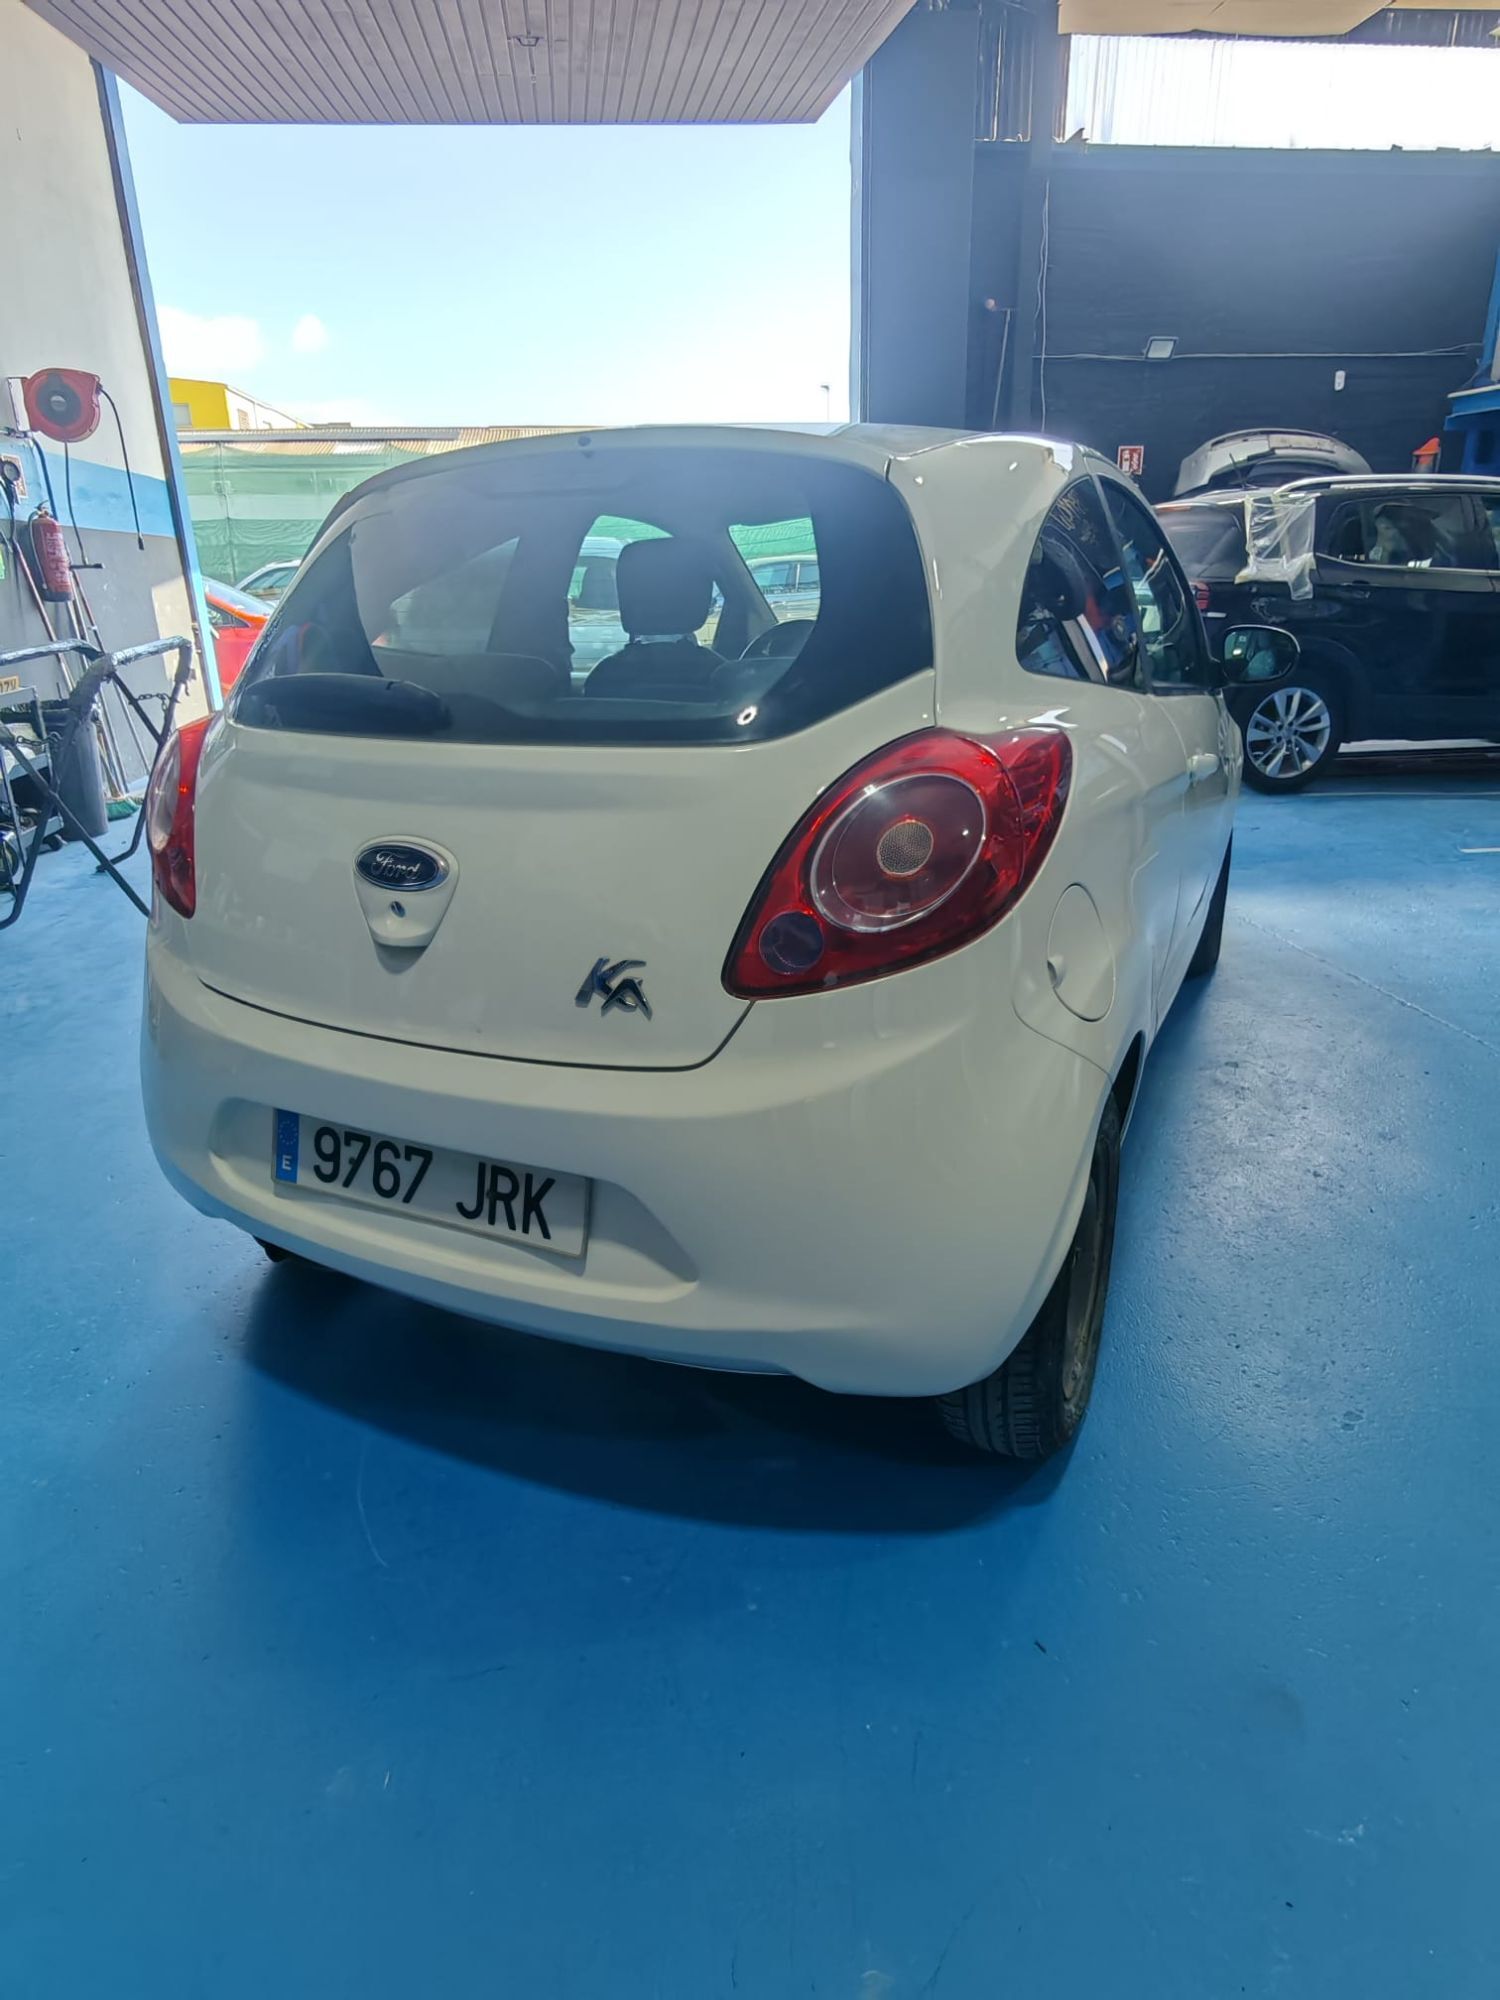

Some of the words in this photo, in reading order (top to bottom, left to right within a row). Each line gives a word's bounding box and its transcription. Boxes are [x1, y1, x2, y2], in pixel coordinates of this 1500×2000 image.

[371, 851, 420, 880] Ford
[281, 1154, 292, 1171] E
[313, 1126, 433, 1204] 9767
[455, 1161, 556, 1240] JRK
